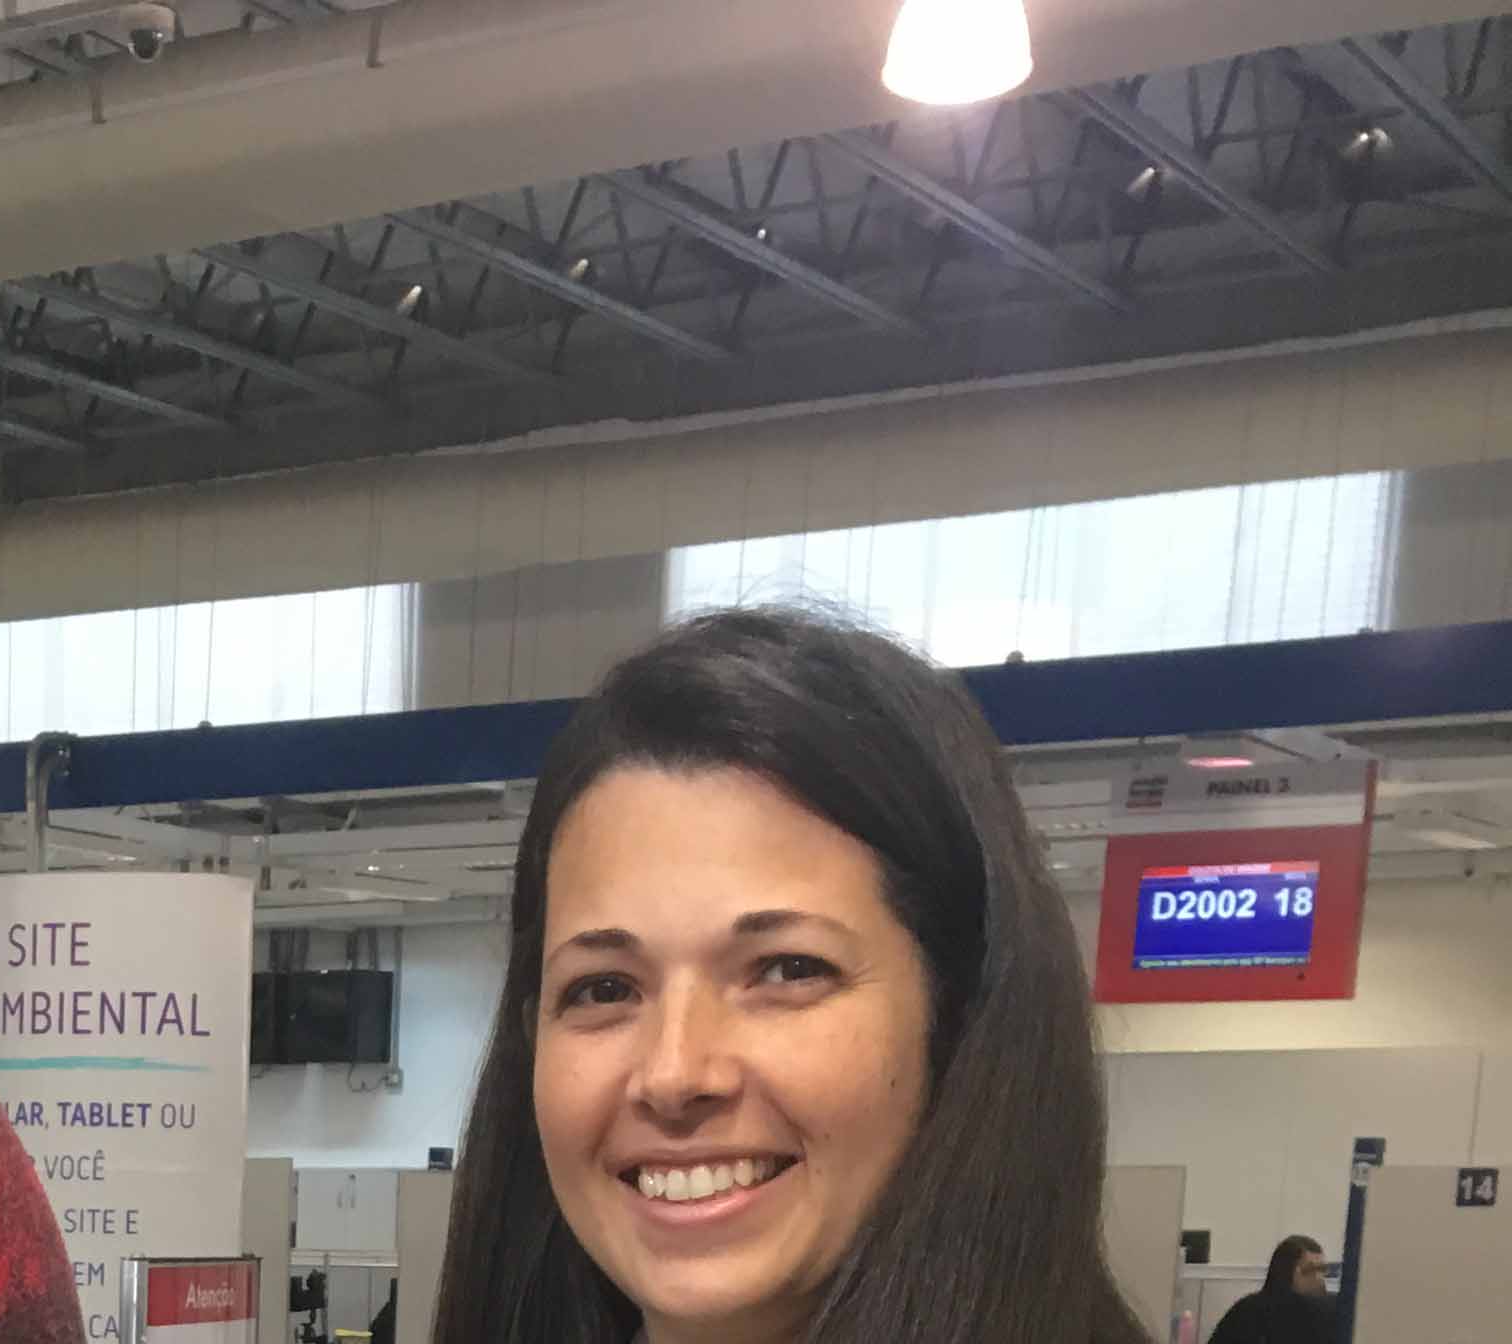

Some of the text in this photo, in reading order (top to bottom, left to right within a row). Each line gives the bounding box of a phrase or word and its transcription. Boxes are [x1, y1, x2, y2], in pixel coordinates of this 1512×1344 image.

[1152, 887, 1313, 920] D2002 18
[8, 923, 91, 966] SITE
[58, 1102, 152, 1128] TABLET
[161, 1104, 195, 1129] OU
[44, 1150, 105, 1180] VOCÊ
[1461, 1175, 1493, 1201] 14
[64, 1209, 139, 1234] SITE E
[73, 1261, 104, 1286] EM
[89, 1315, 119, 1338] CA
